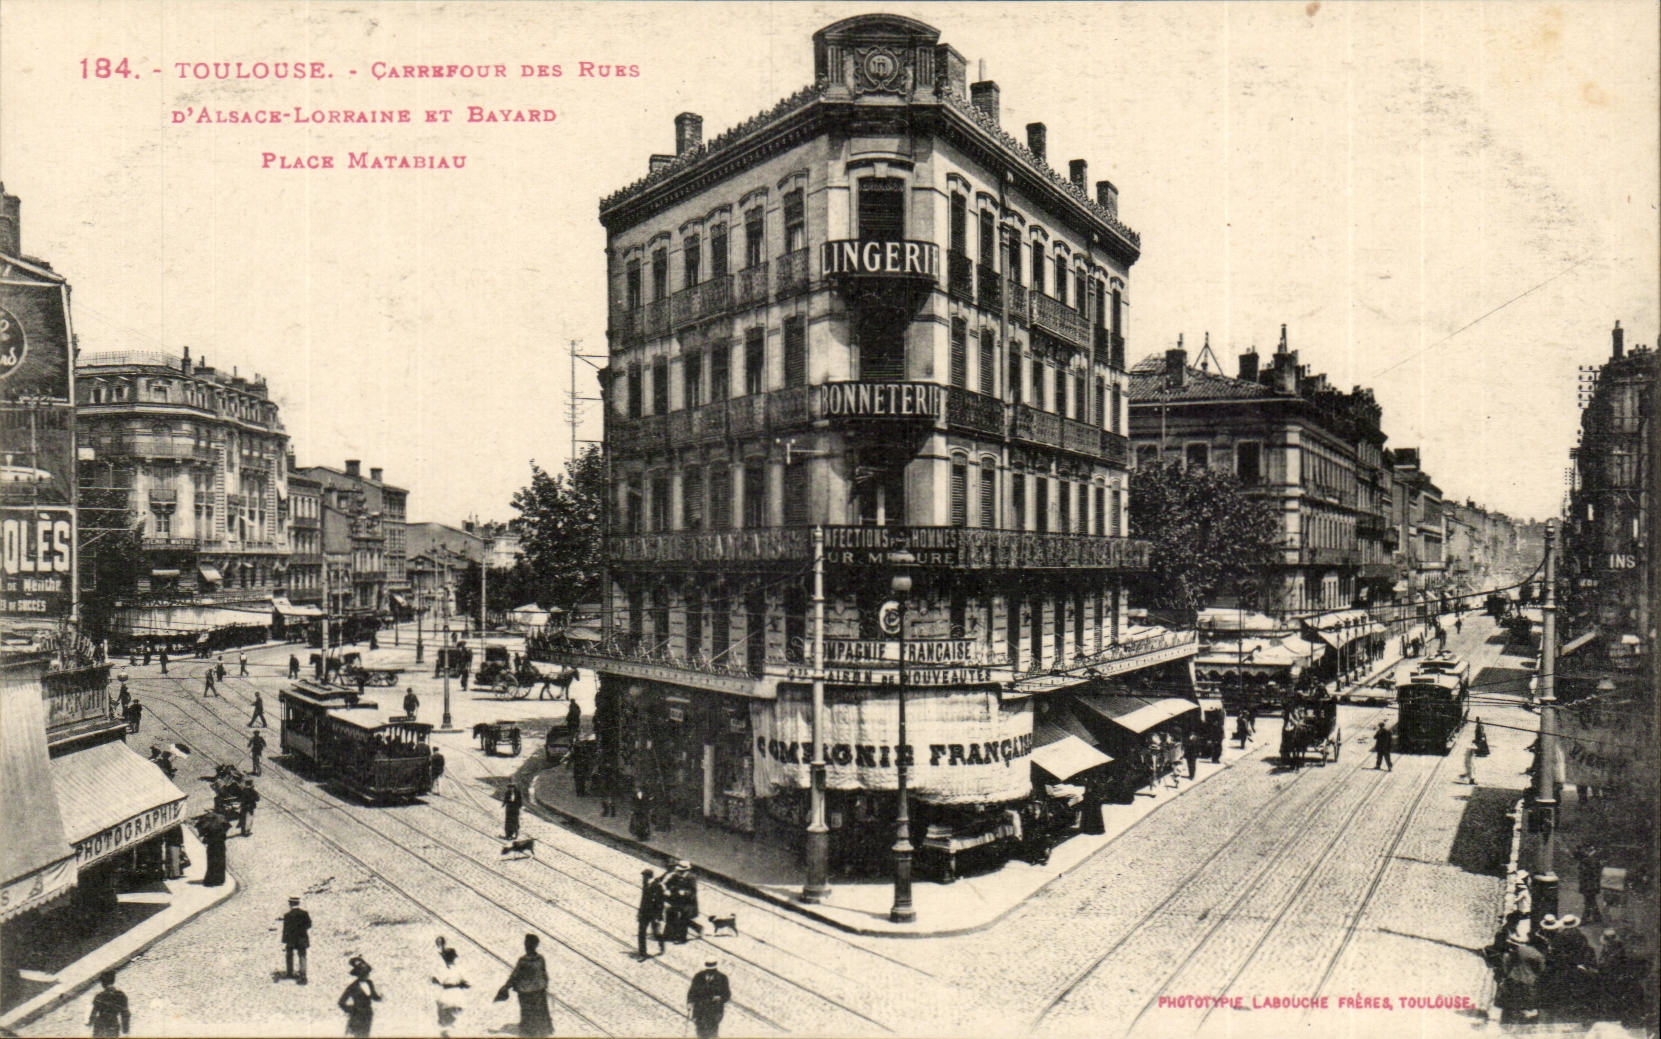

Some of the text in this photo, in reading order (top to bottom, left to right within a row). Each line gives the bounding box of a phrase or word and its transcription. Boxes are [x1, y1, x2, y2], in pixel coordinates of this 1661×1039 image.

[821, 384, 939, 416] BONNETERIE
[868, 552, 955, 565] MURE
[75, 801, 181, 863] PHOTOGRAPHIE
